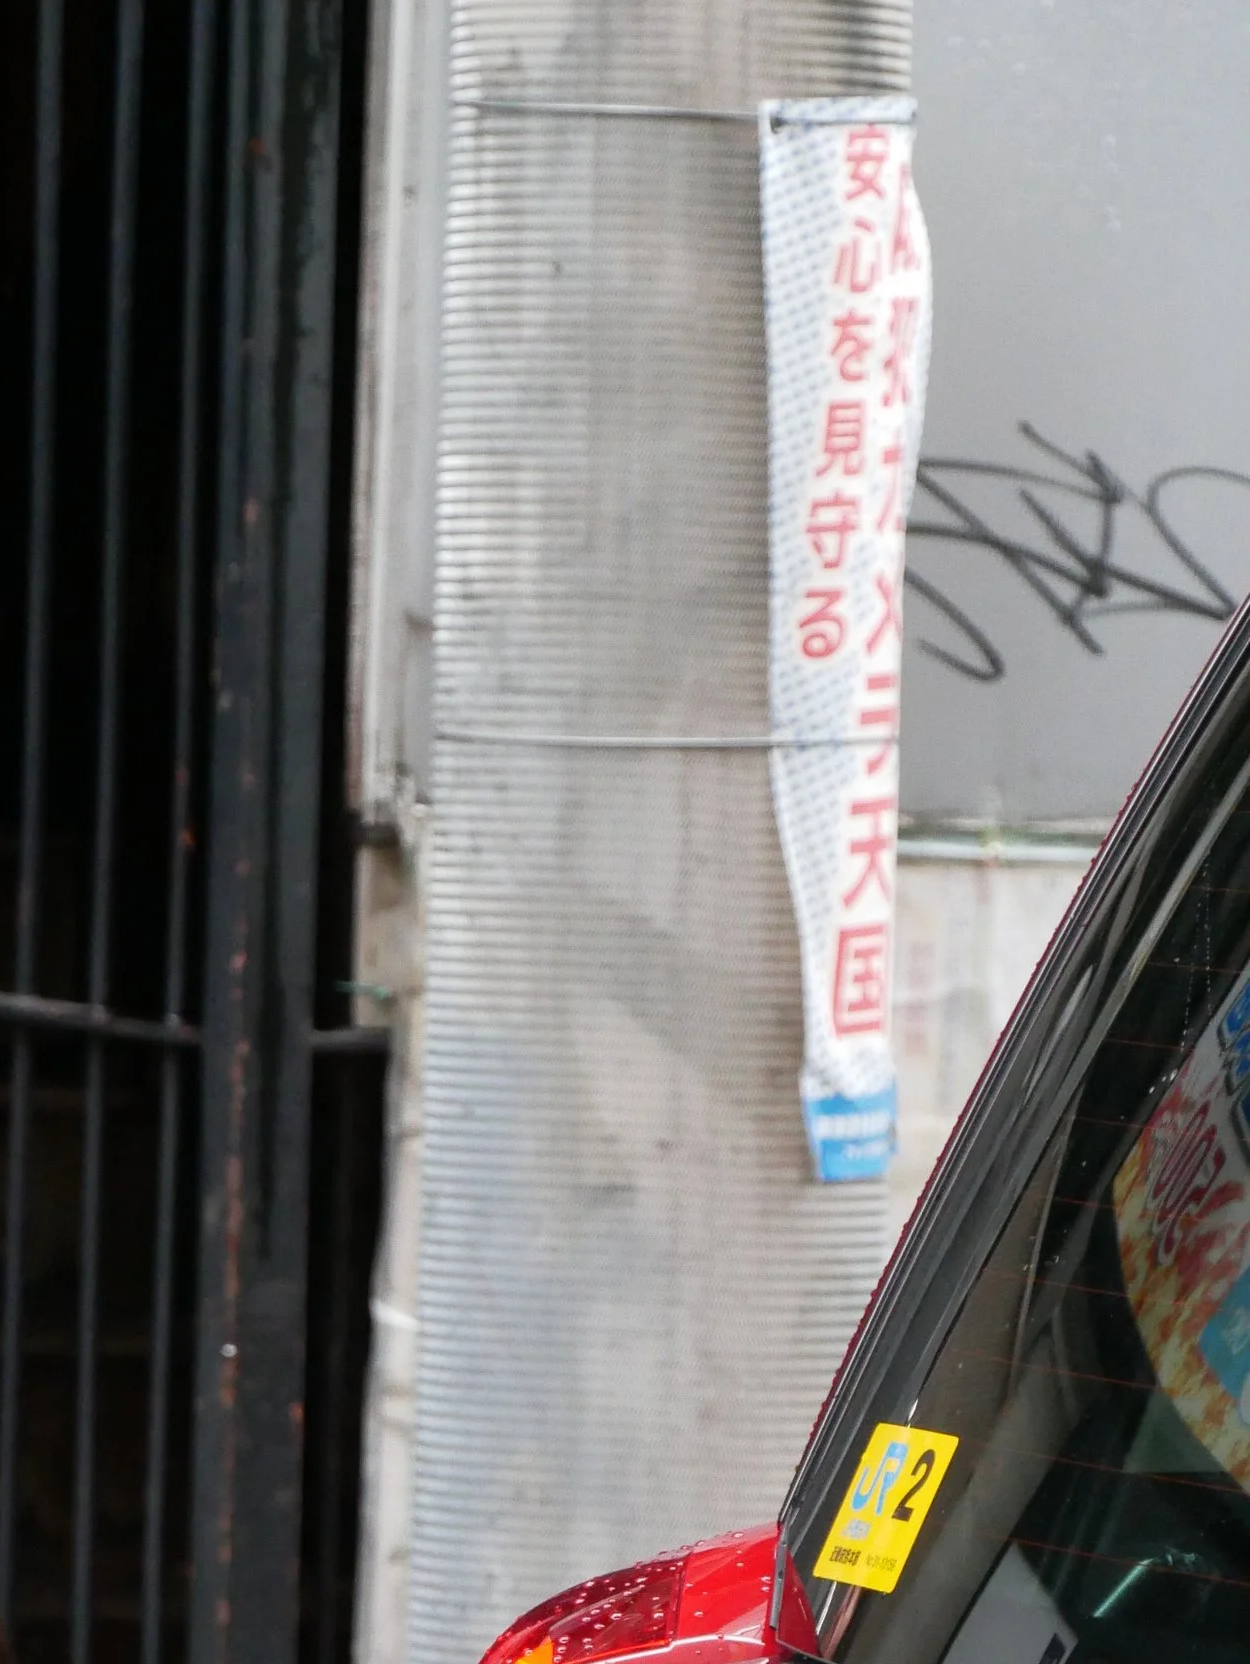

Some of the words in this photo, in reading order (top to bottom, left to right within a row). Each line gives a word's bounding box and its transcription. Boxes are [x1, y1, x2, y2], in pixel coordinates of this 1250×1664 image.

[797, 123, 889, 661] 安心を見守る
[891, 1448, 937, 1523] 2
